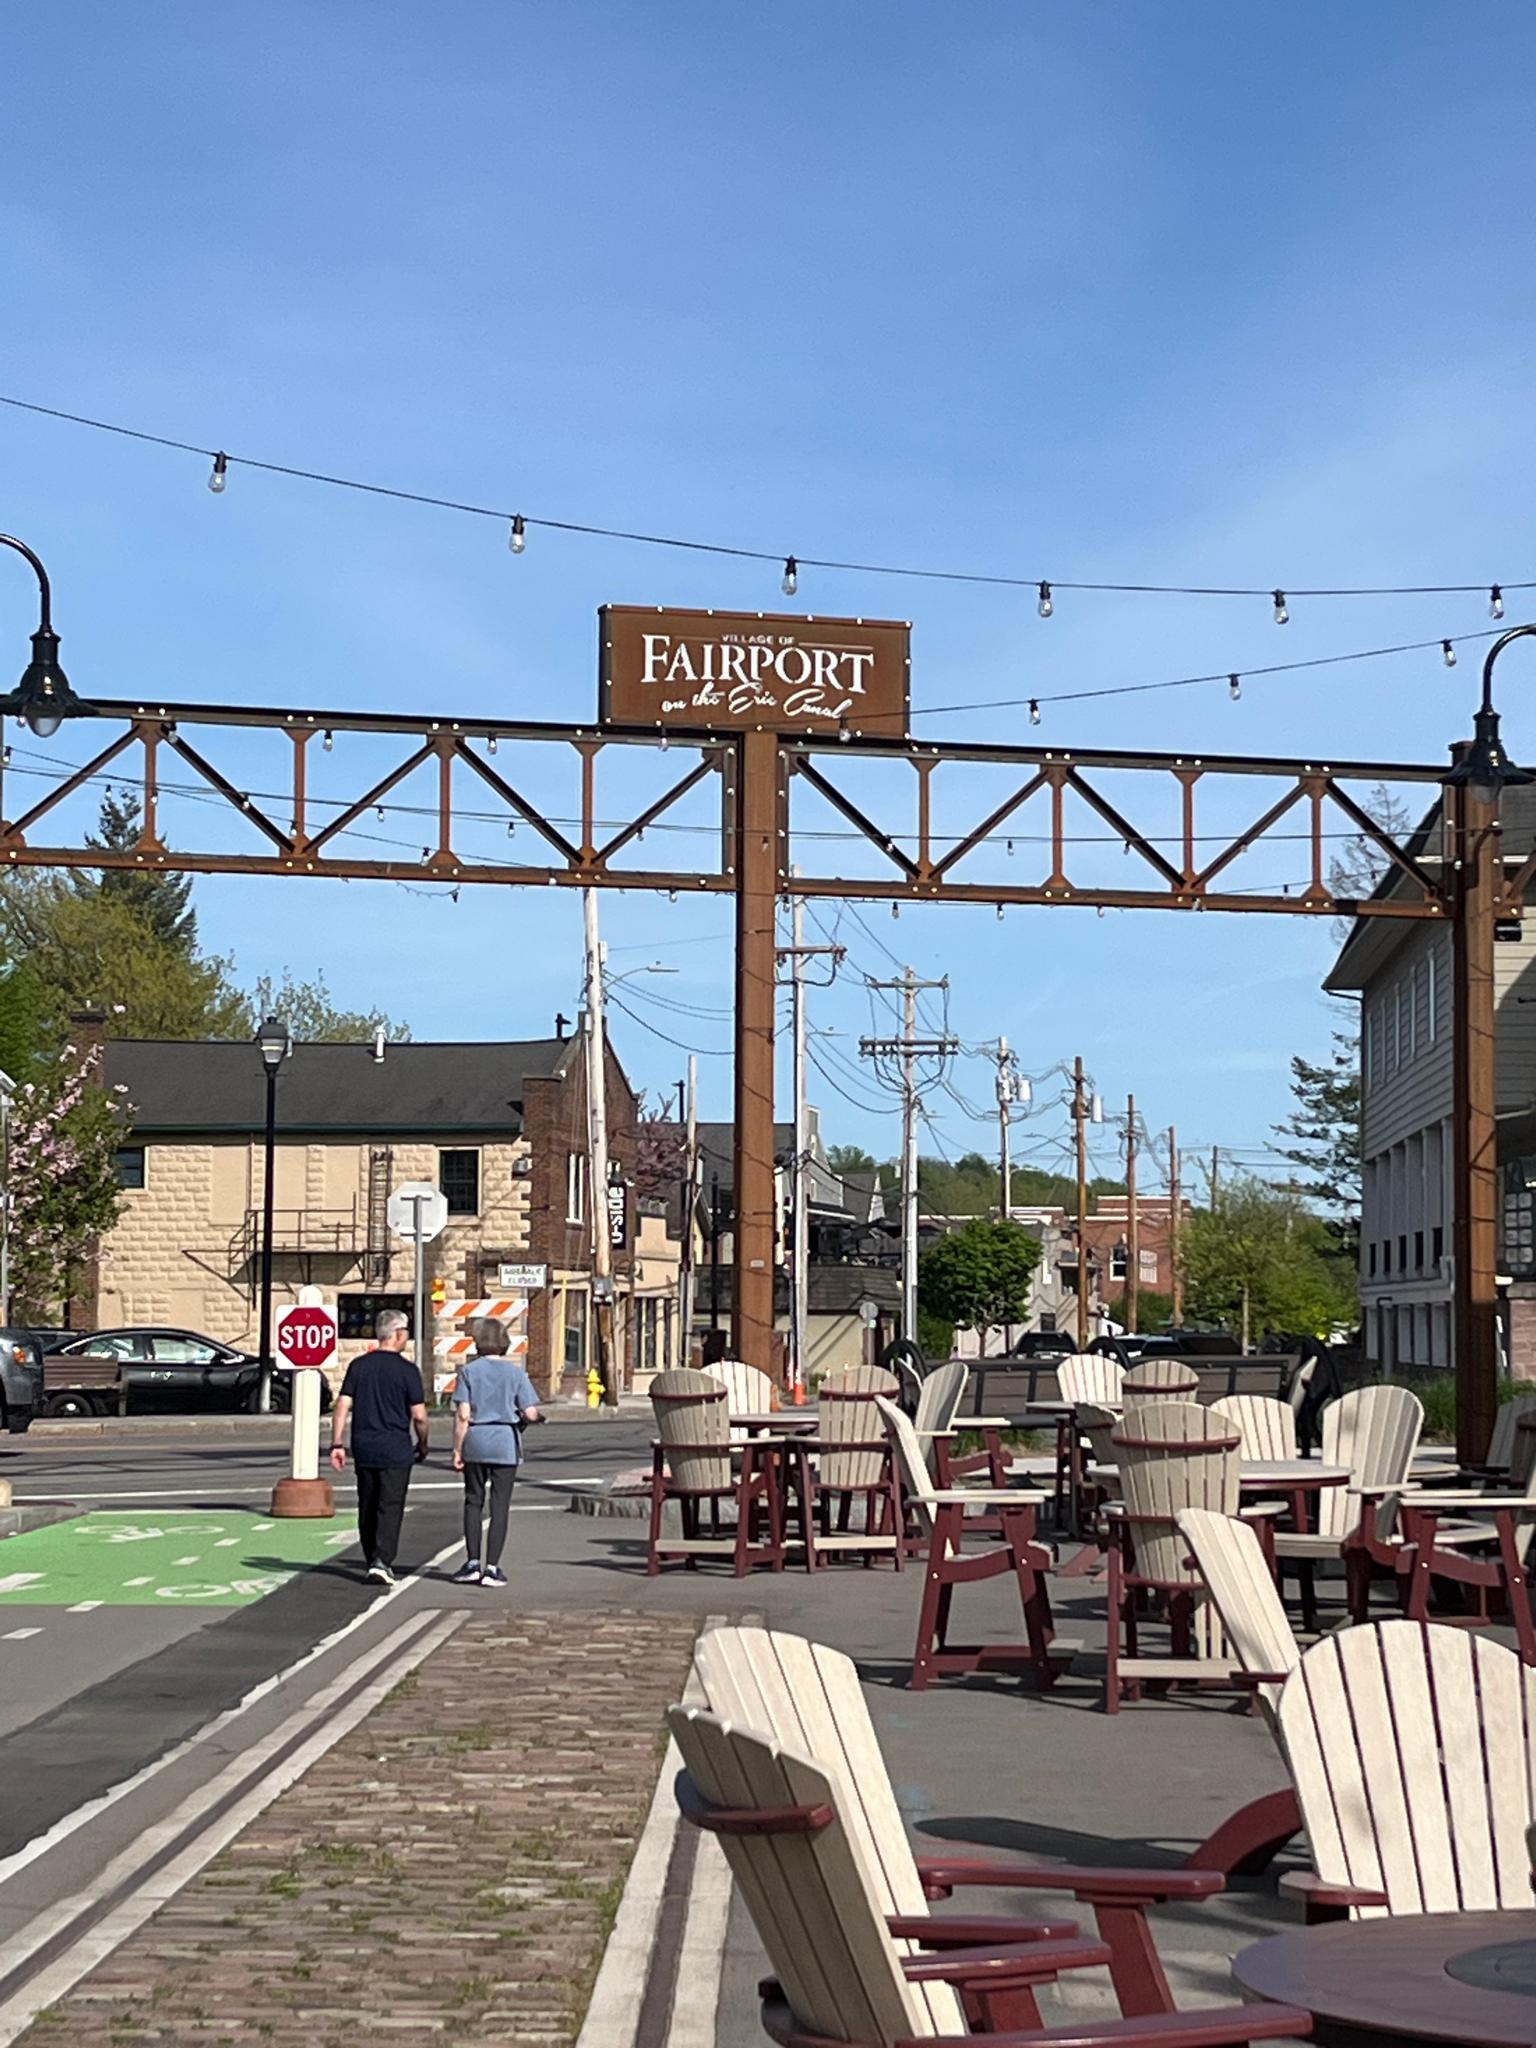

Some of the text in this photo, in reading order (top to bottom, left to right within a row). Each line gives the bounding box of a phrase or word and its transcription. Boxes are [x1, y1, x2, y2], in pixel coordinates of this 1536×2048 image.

[721, 634, 796, 646] VILLAGE OF
[640, 634, 875, 695] FAIRPORT
[661, 681, 853, 720] on the Erie Canal
[280, 1325, 335, 1349] STOP
